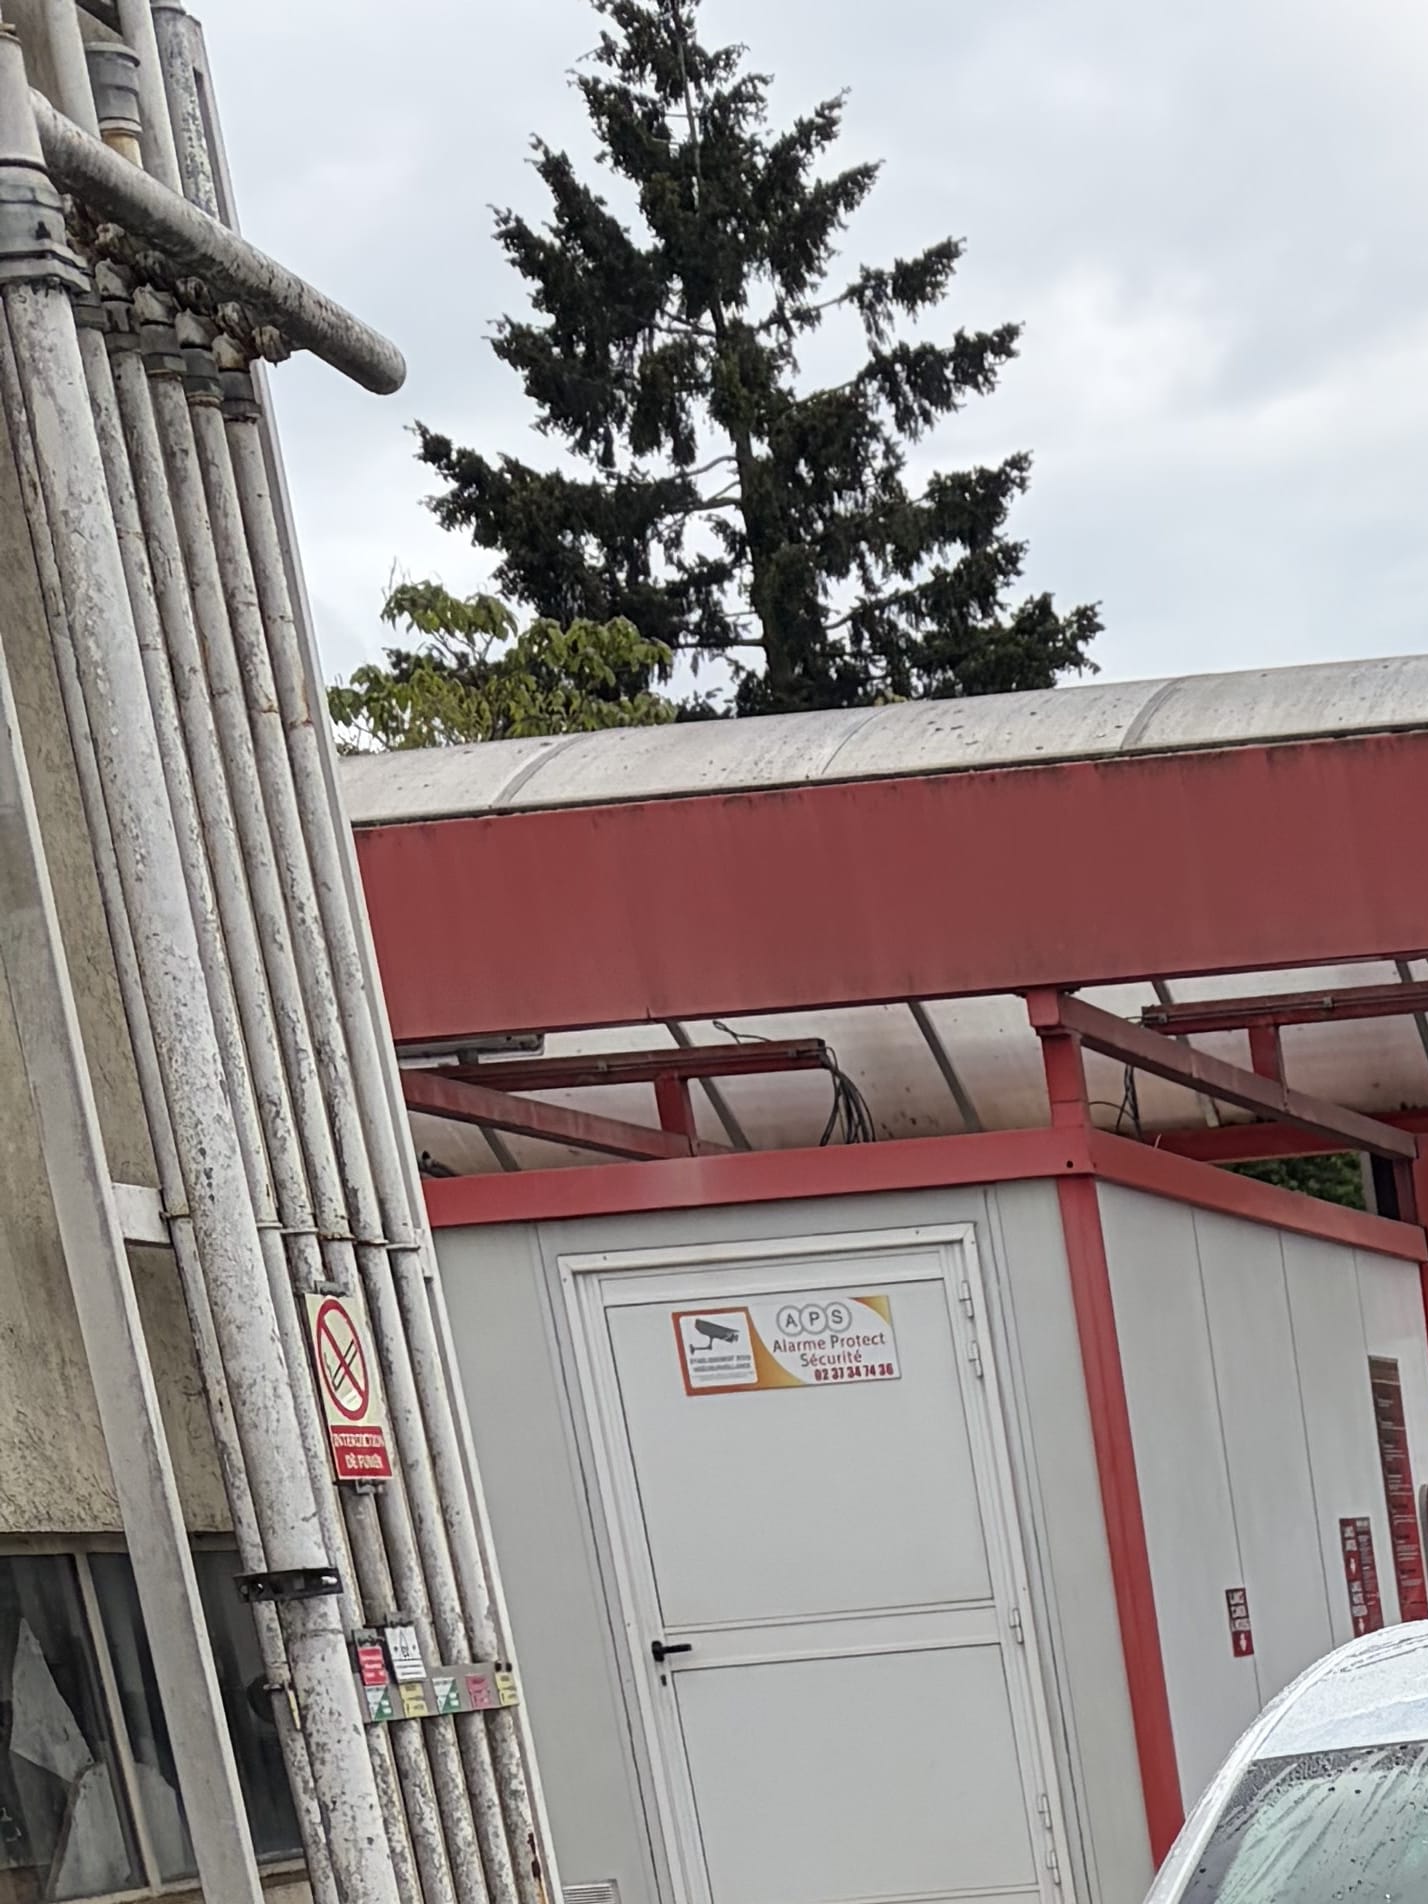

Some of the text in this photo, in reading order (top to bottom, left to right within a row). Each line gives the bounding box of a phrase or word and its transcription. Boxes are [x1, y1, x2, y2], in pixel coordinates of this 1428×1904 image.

[773, 1332, 886, 1353] Alarme Protect
[800, 1350, 862, 1367] Sécurité
[814, 1368, 829, 1381] 02
[847, 1366, 861, 1379] 34
[864, 1364, 876, 1377] 74
